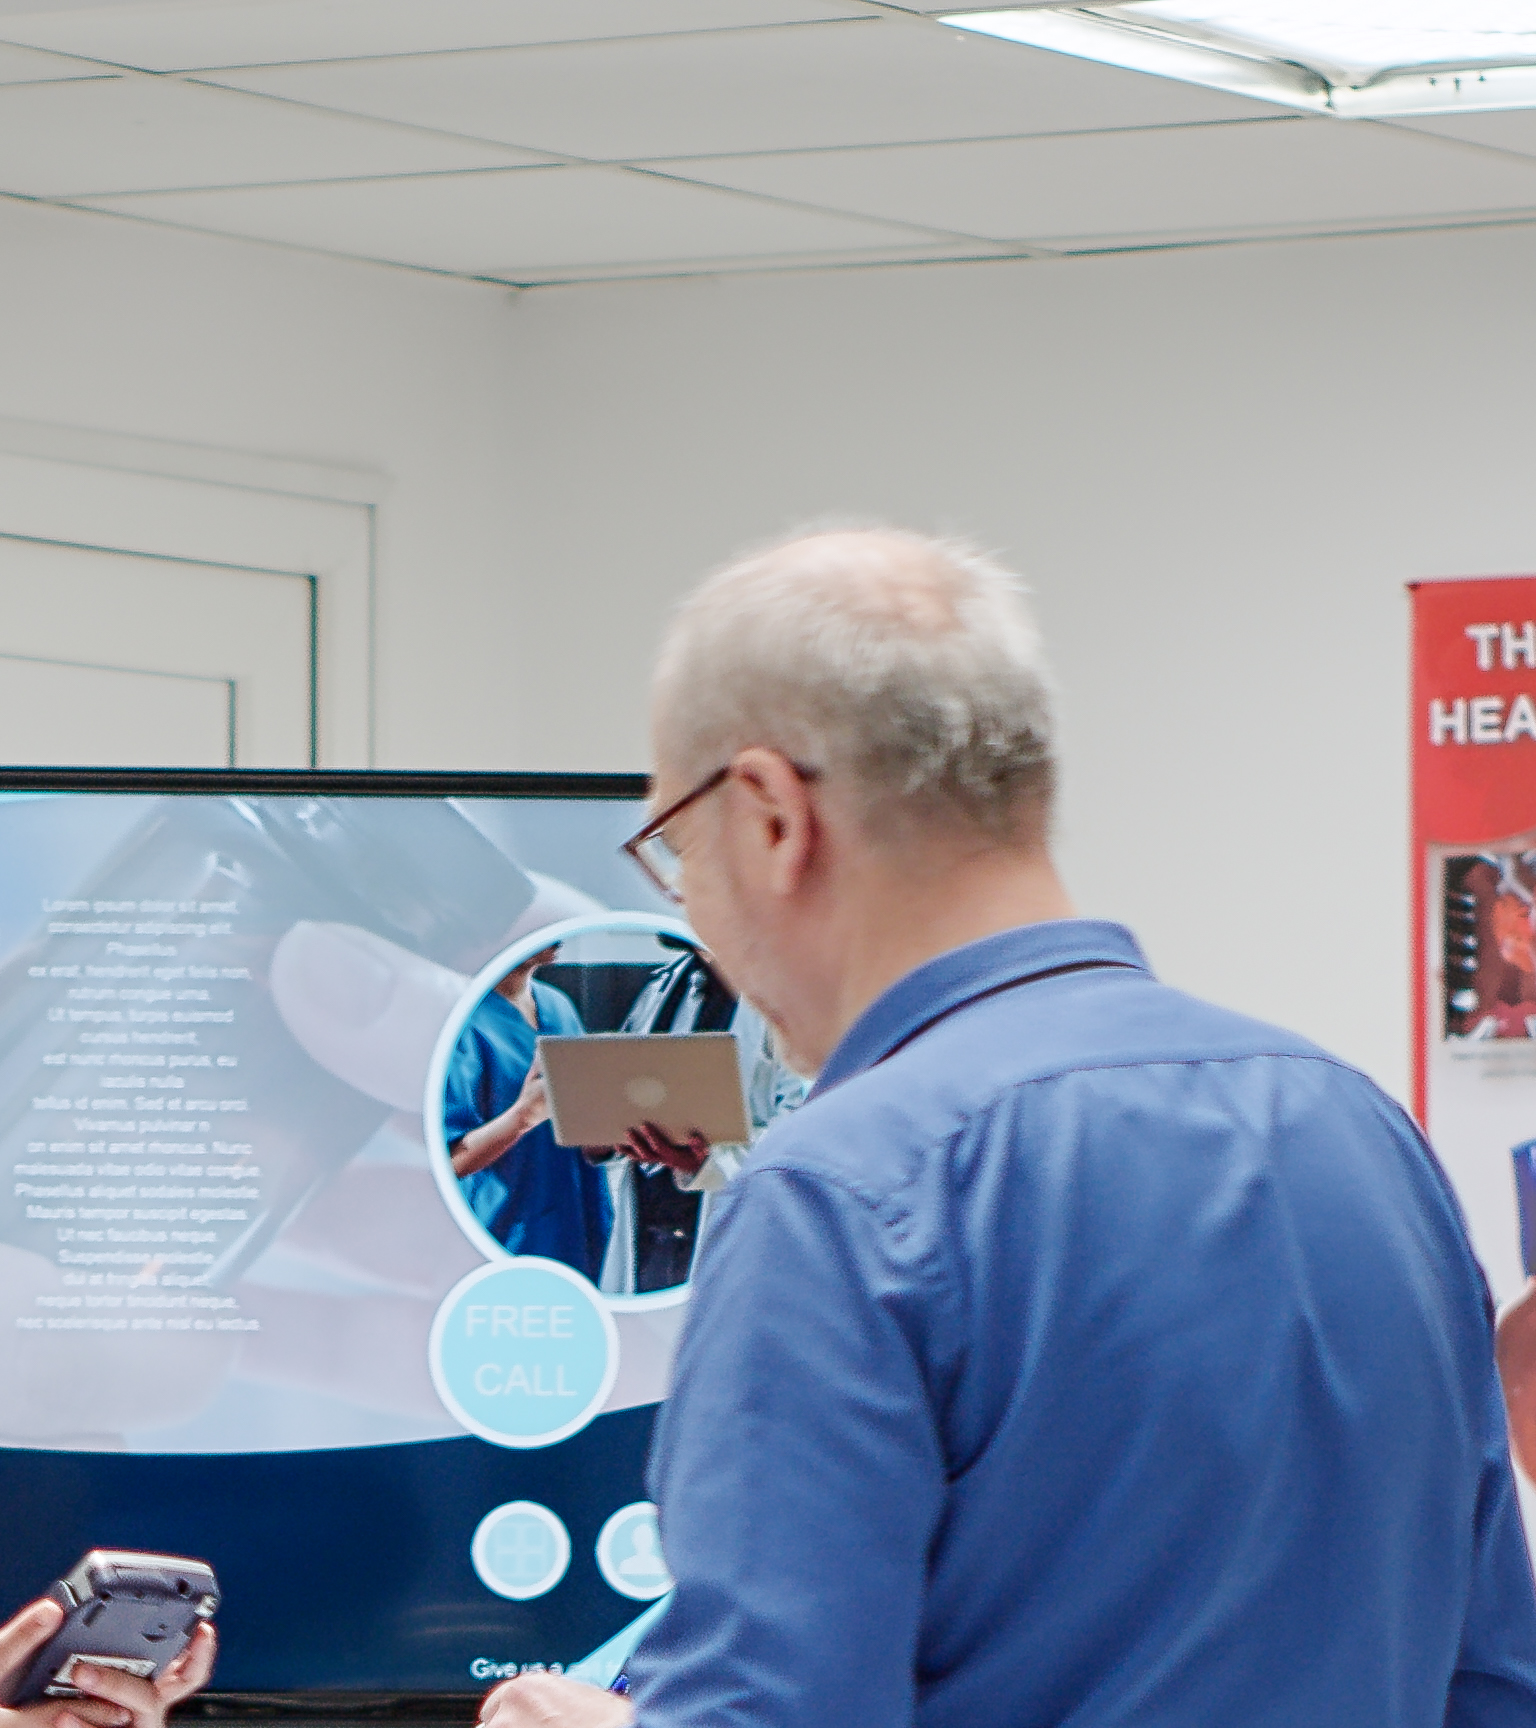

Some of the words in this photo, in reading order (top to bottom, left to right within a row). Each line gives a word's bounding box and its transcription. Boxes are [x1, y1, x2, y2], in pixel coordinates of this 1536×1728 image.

[465, 1305, 574, 1338] FREE
[474, 1363, 578, 1396] CALL
[471, 1657, 519, 1679] Give
